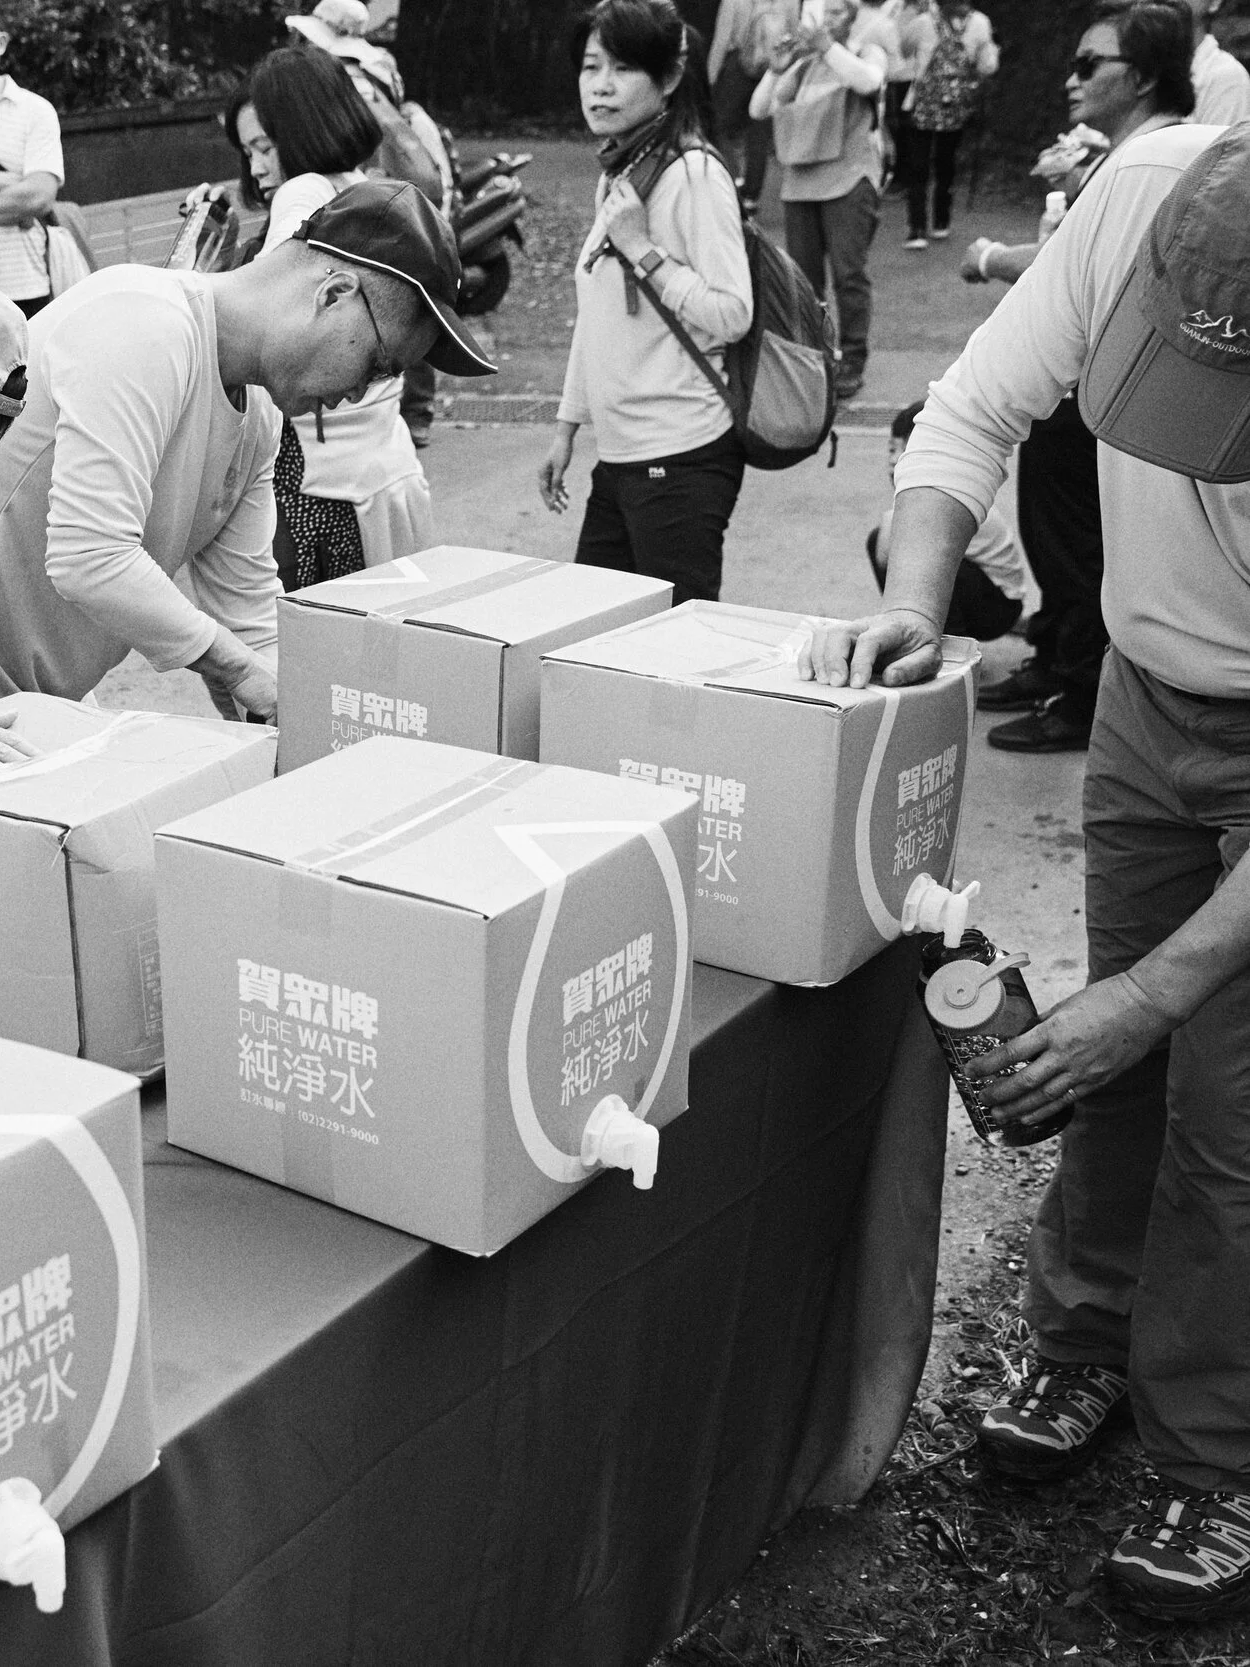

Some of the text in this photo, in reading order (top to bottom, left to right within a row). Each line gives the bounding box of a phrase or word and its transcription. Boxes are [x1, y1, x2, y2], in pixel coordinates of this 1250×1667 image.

[697, 816, 743, 842] TER
[896, 783, 954, 832] PURE WATER
[893, 808, 951, 876] 純淨水
[239, 1008, 378, 1069] PURE WATER
[562, 979, 652, 1055] PURE WATER
[238, 1033, 376, 1118] 純淨水
[561, 1010, 649, 1106] 純淨水
[298, 1110, 379, 1145] (02)2291-9000
